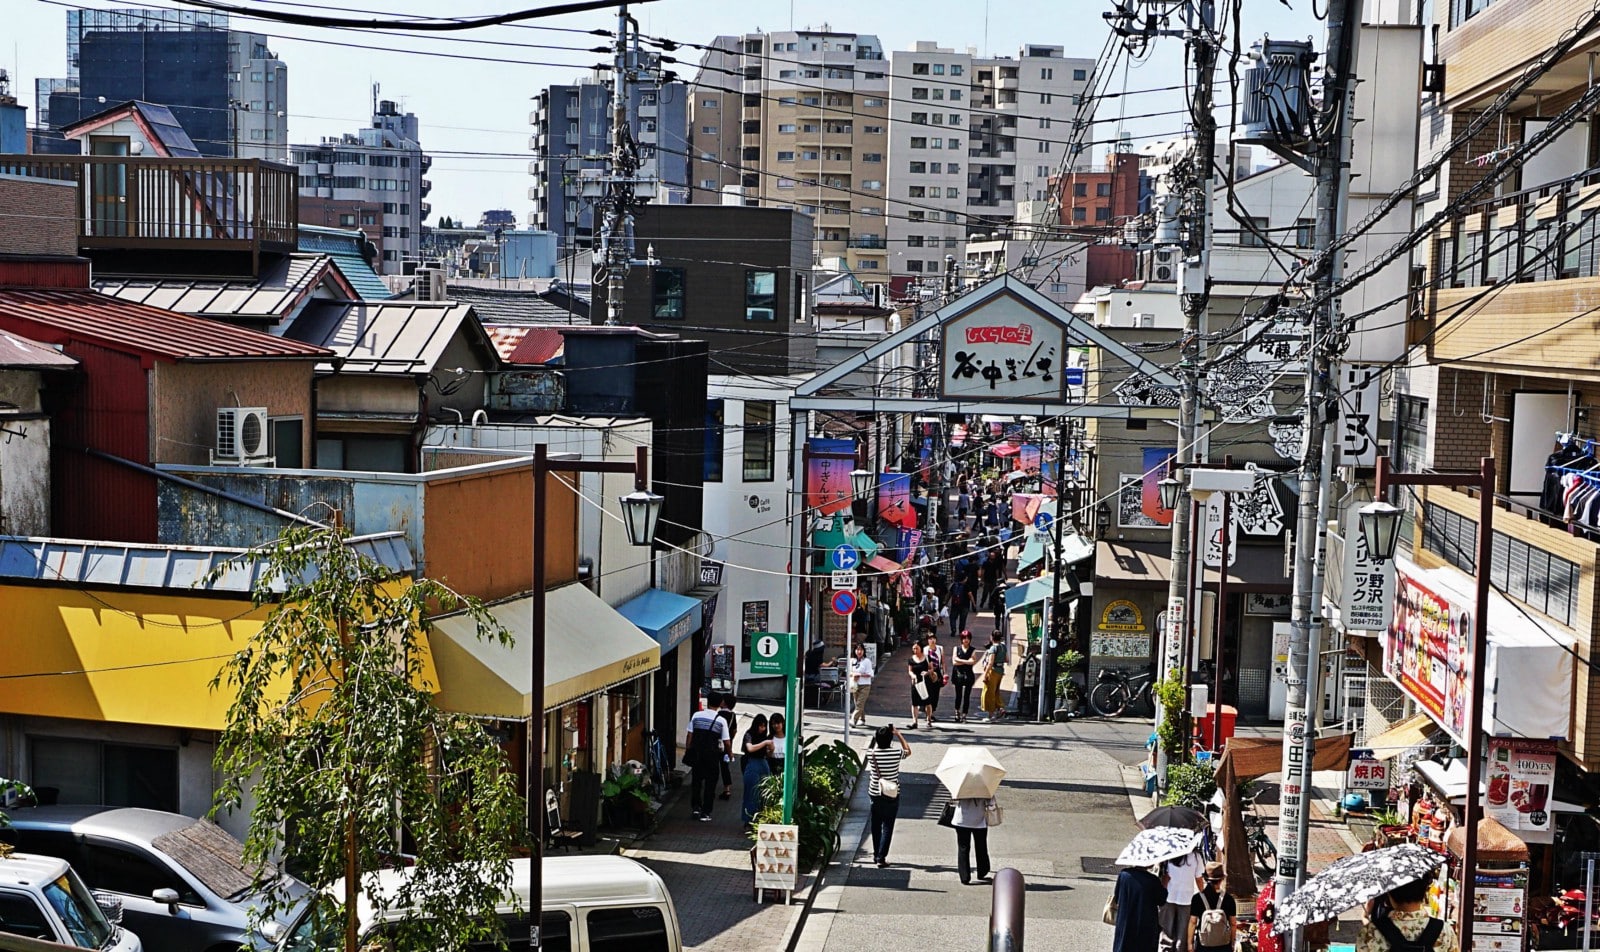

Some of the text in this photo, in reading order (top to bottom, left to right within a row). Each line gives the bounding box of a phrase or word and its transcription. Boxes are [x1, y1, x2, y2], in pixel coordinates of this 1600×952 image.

[966, 323, 1033, 345] ひぐらしの里
[951, 340, 1056, 390] 谷中ぎんざ
[1354, 765, 1385, 780] 焼肉
